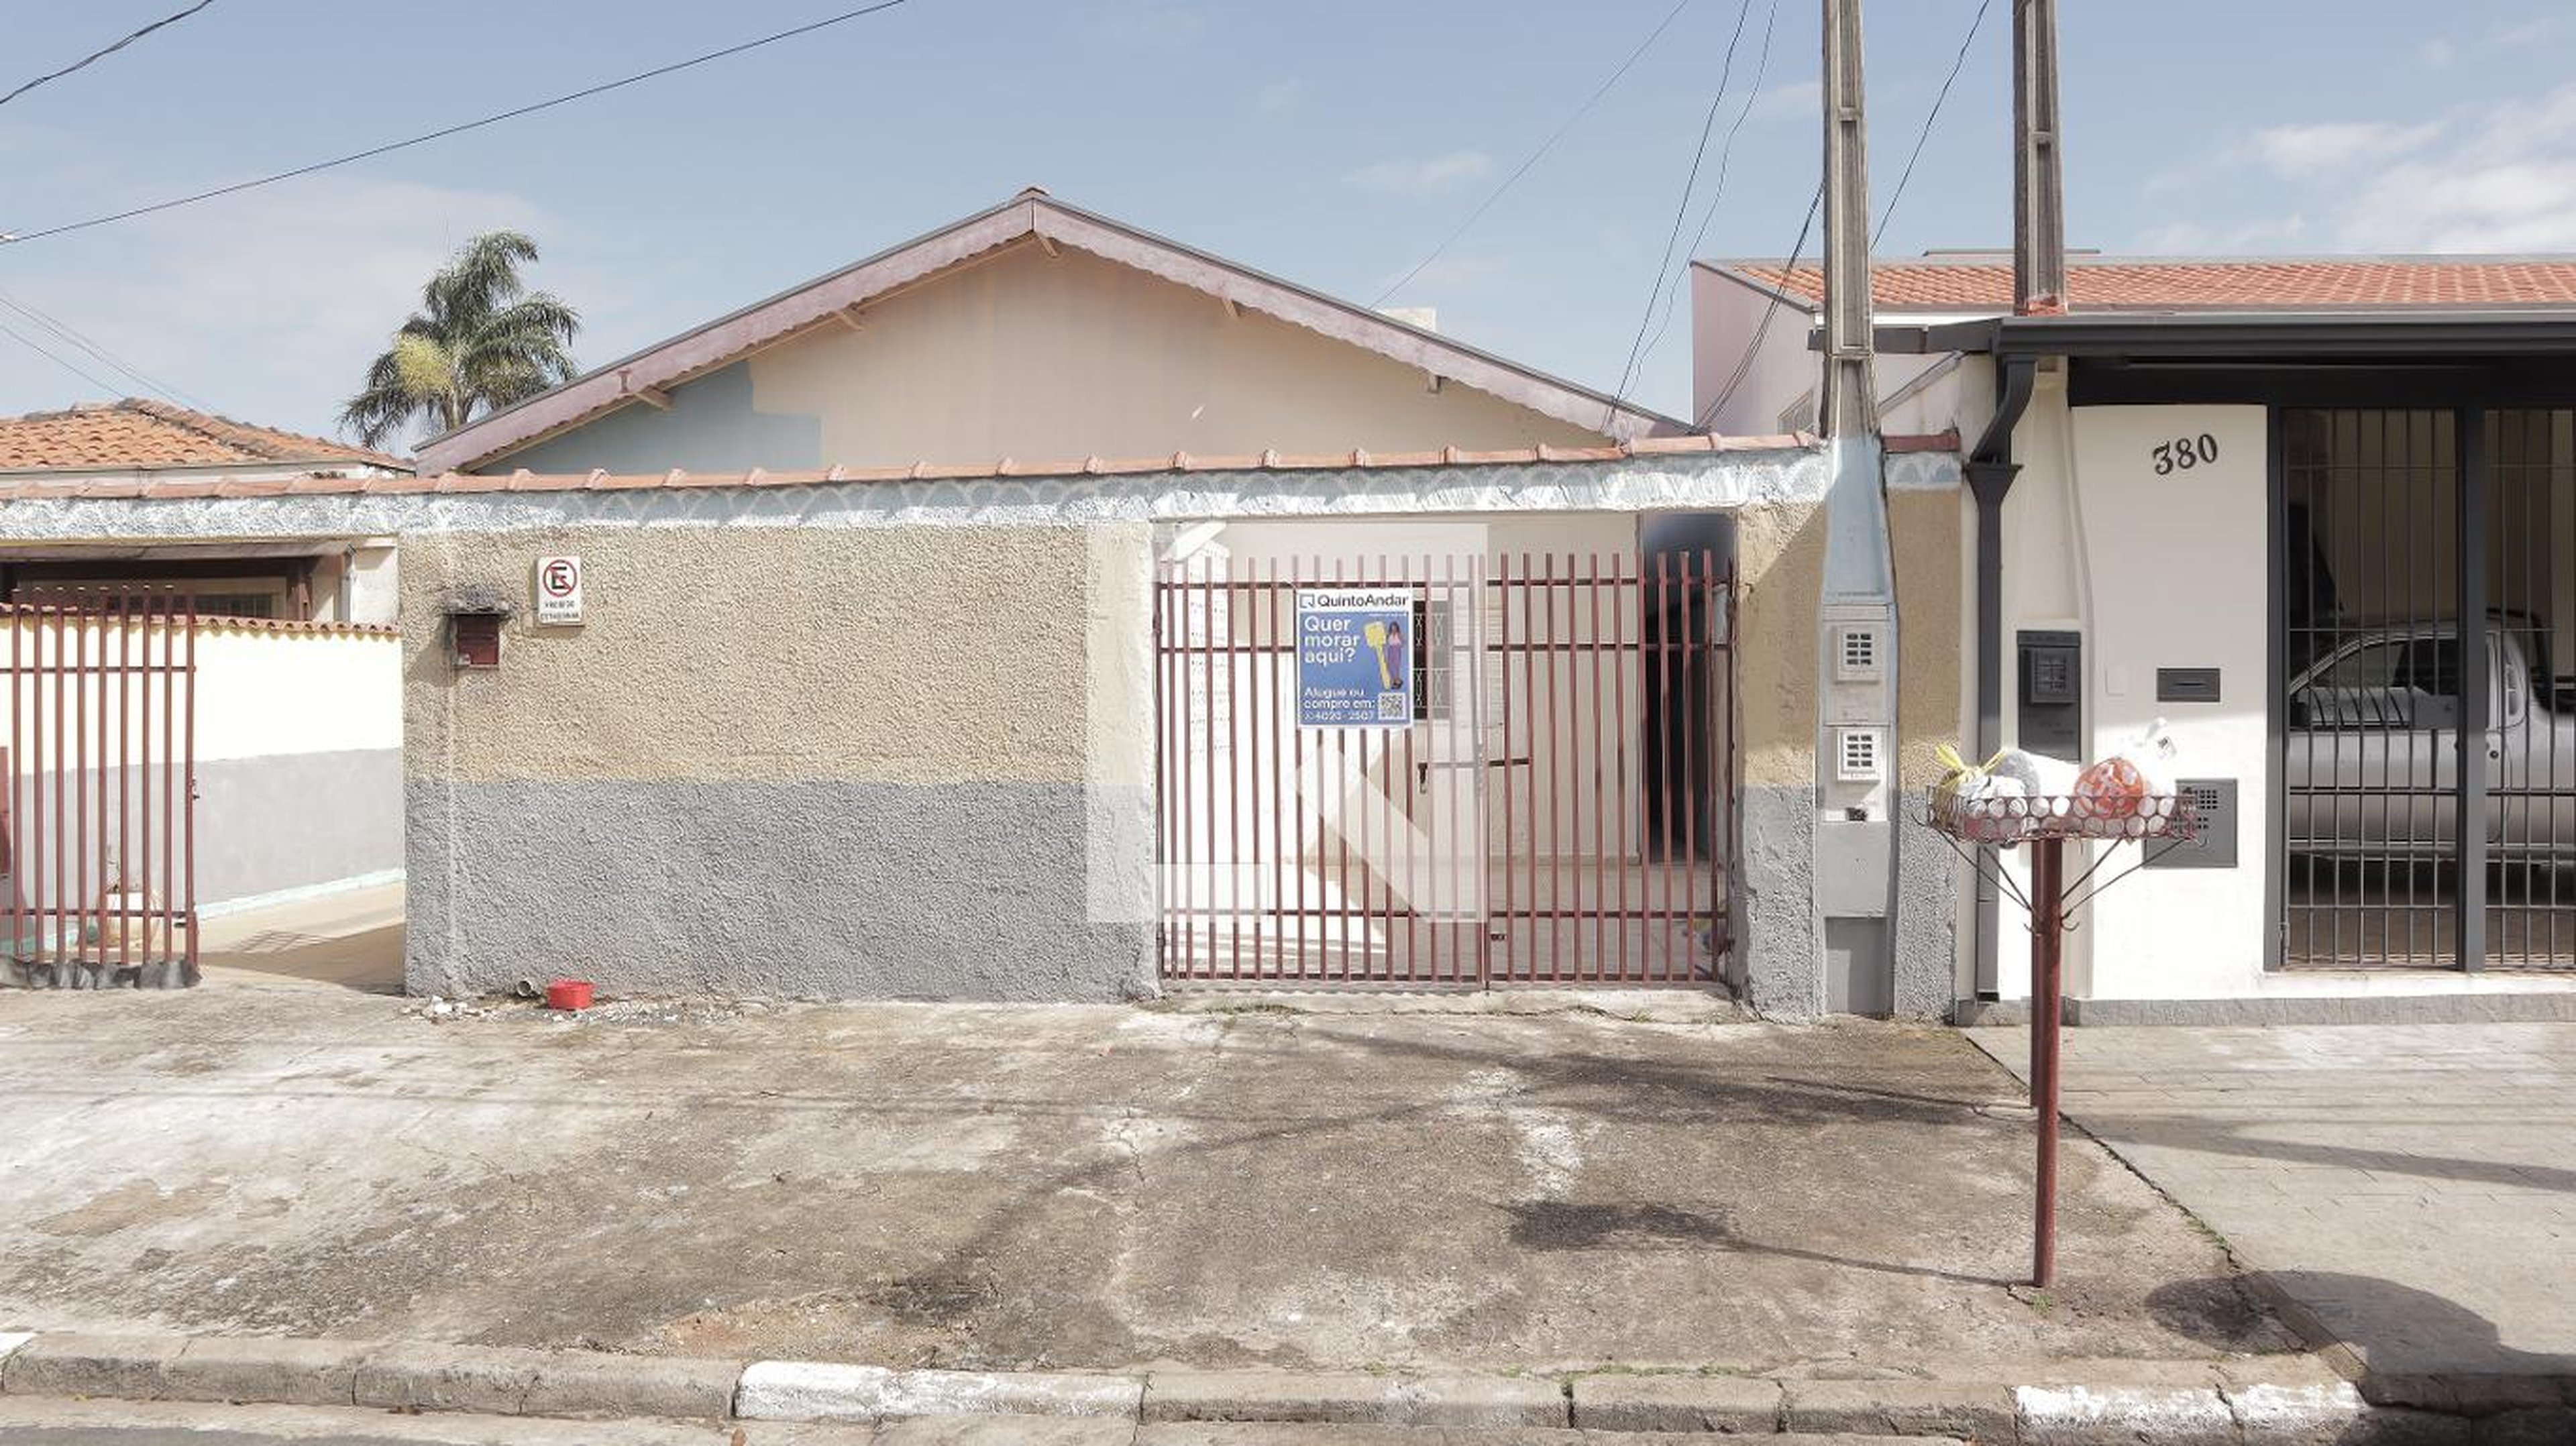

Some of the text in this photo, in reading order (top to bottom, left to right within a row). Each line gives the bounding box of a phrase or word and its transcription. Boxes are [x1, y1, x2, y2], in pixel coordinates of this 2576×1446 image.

[2153, 434, 2217, 475] 380
[1318, 594, 1407, 607] QuintoAndar
[1304, 616, 1350, 631] Quer
[1304, 636, 1360, 647] morar
[1304, 648, 1356, 667] aqui?
[1305, 687, 1346, 699] Alugue
[1304, 700, 1350, 710] compre
